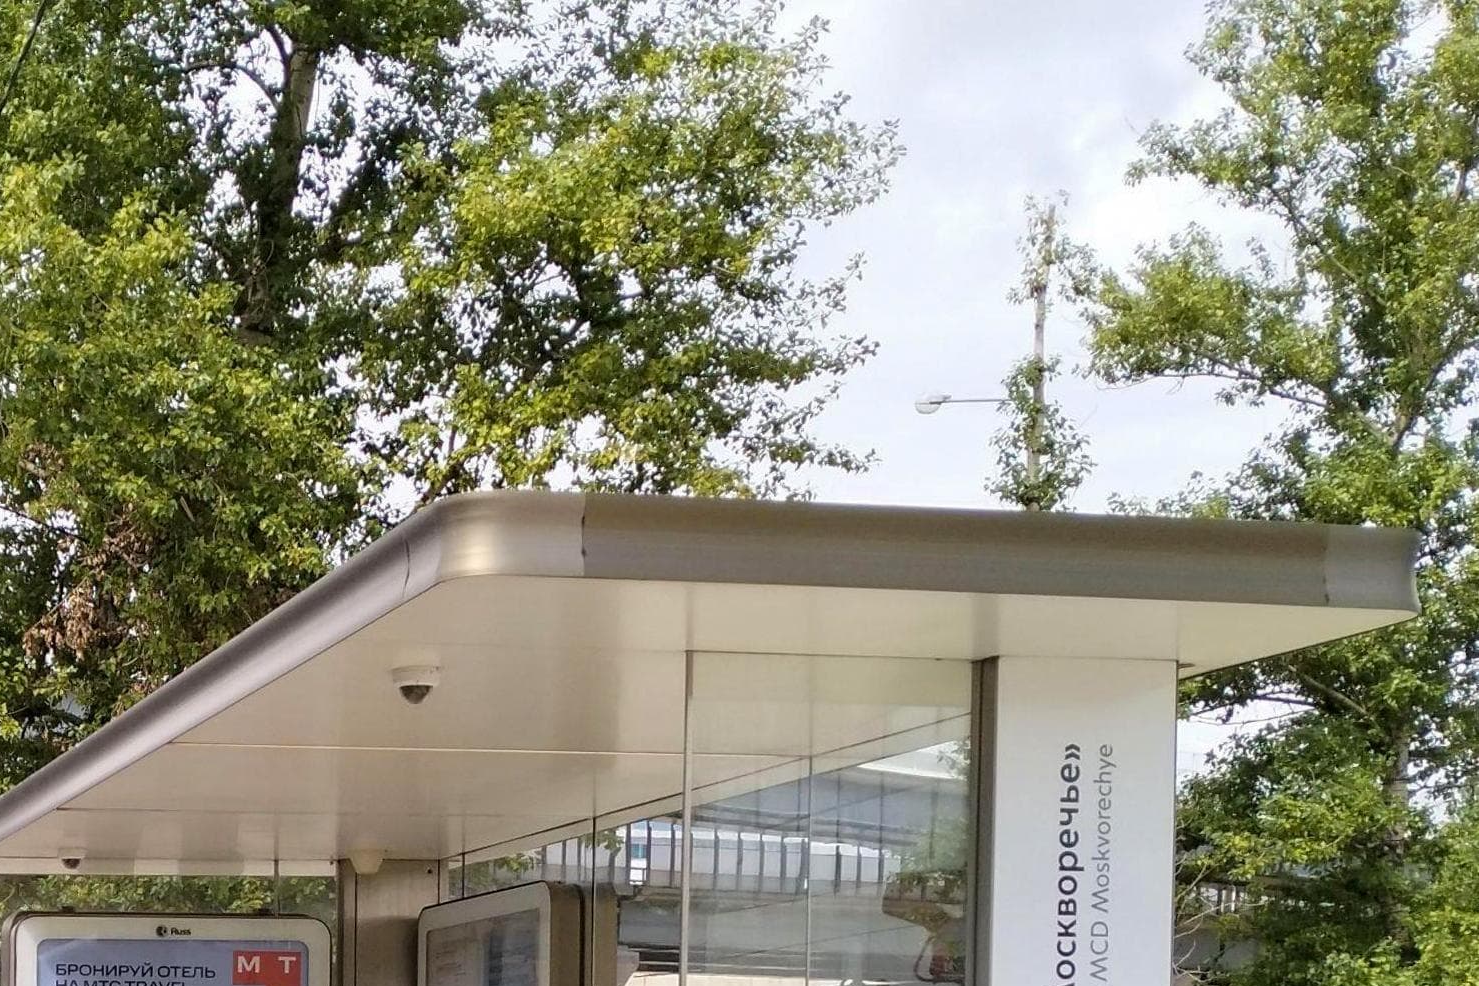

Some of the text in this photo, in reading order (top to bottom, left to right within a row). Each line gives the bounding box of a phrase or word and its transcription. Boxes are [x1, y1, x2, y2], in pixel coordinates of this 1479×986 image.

[1090, 743, 1117, 913] Moskvorechye
[171, 928, 192, 936] Russ
[1090, 920, 1109, 982] MCD
[55, 962, 216, 979] БРОНИРУЙ ОТЕЛЬ
